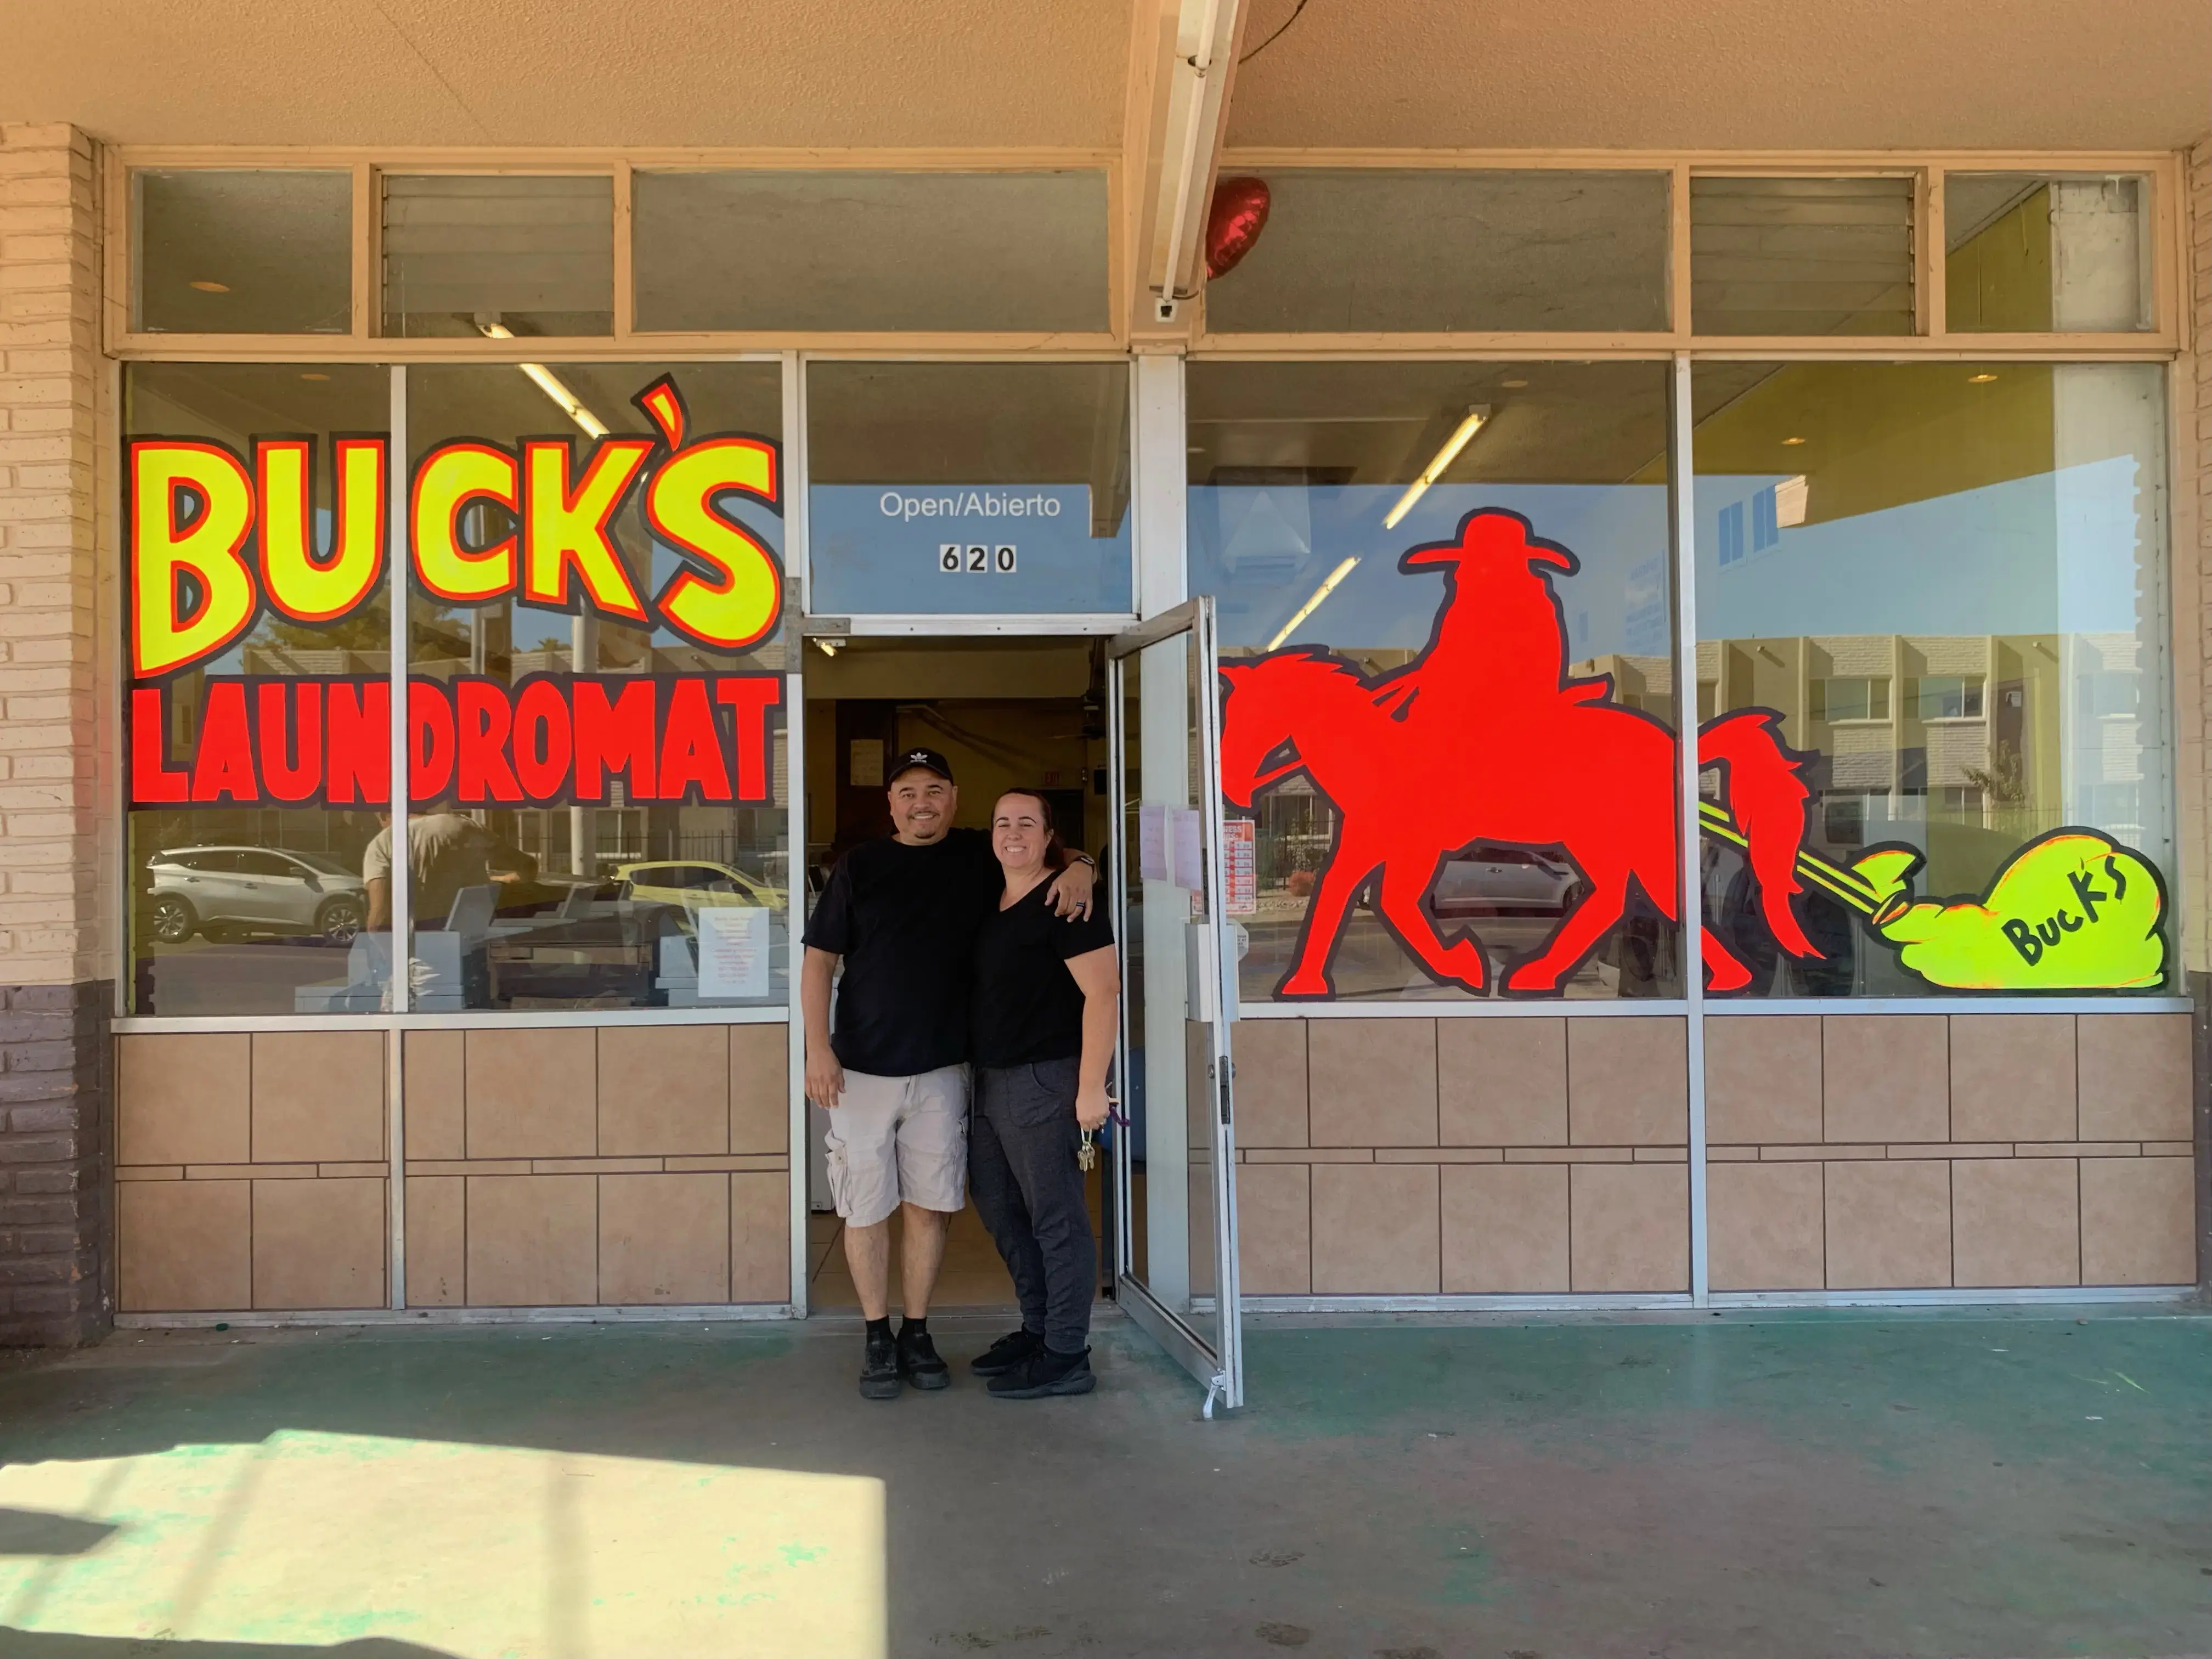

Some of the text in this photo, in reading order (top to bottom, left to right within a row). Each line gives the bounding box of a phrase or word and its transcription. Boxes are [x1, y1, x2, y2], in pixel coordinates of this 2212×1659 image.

[131, 383, 781, 680] BUCK'S
[879, 492, 1060, 522] Open/Abierto
[941, 546, 1015, 572] 620
[132, 677, 780, 803] LAUNDROMAT
